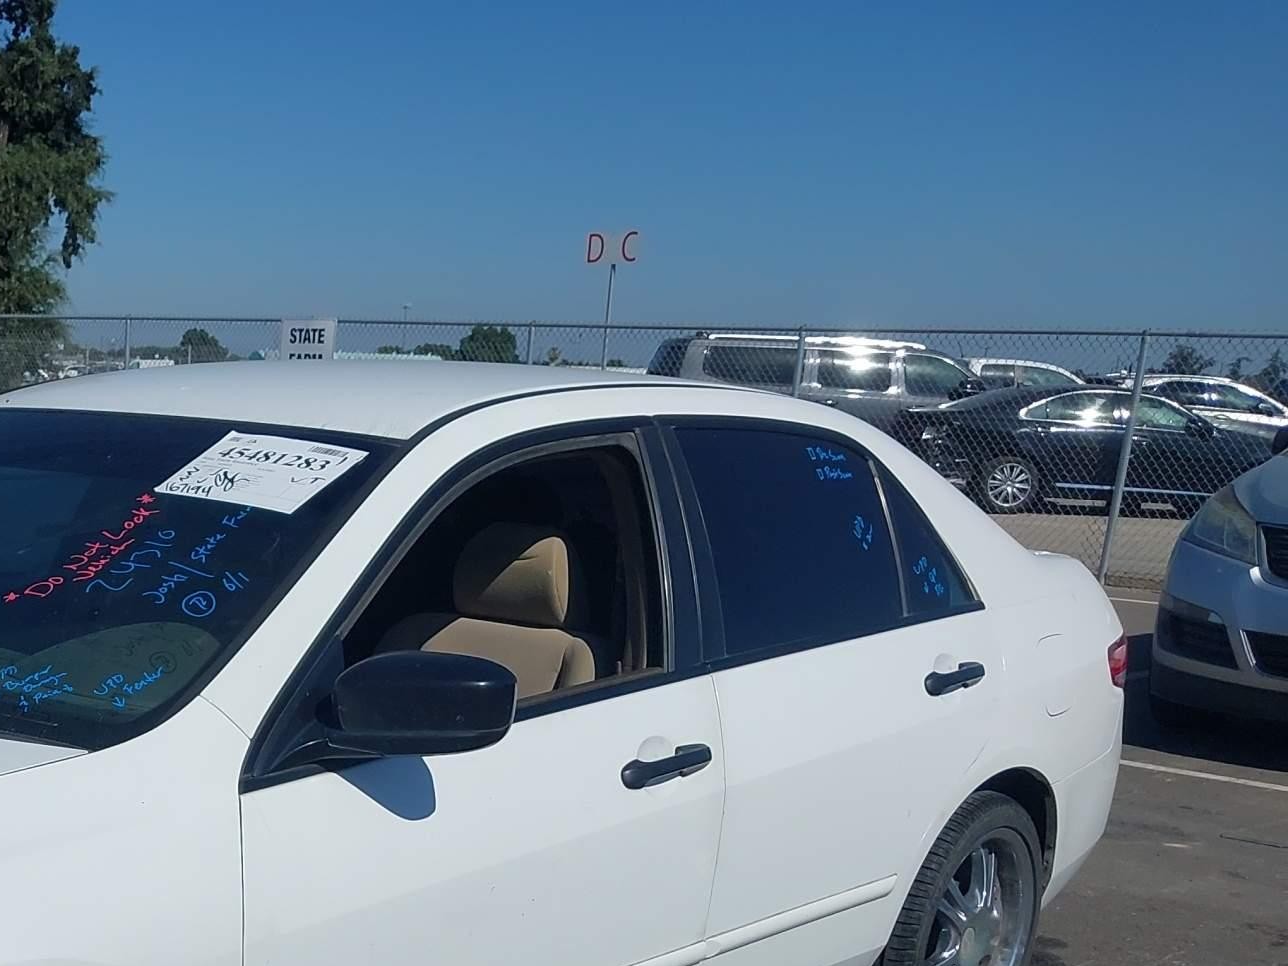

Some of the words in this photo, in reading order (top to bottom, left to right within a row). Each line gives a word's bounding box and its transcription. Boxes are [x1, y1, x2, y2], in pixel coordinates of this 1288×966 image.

[586, 233, 605, 264] D
[621, 231, 639, 262] C
[289, 327, 326, 344] STATE
[218, 446, 330, 472] 45481283
[23, 576, 65, 598] Do
[62, 541, 109, 571] Not
[100, 506, 161, 541] Lock
[190, 532, 227, 563] State
